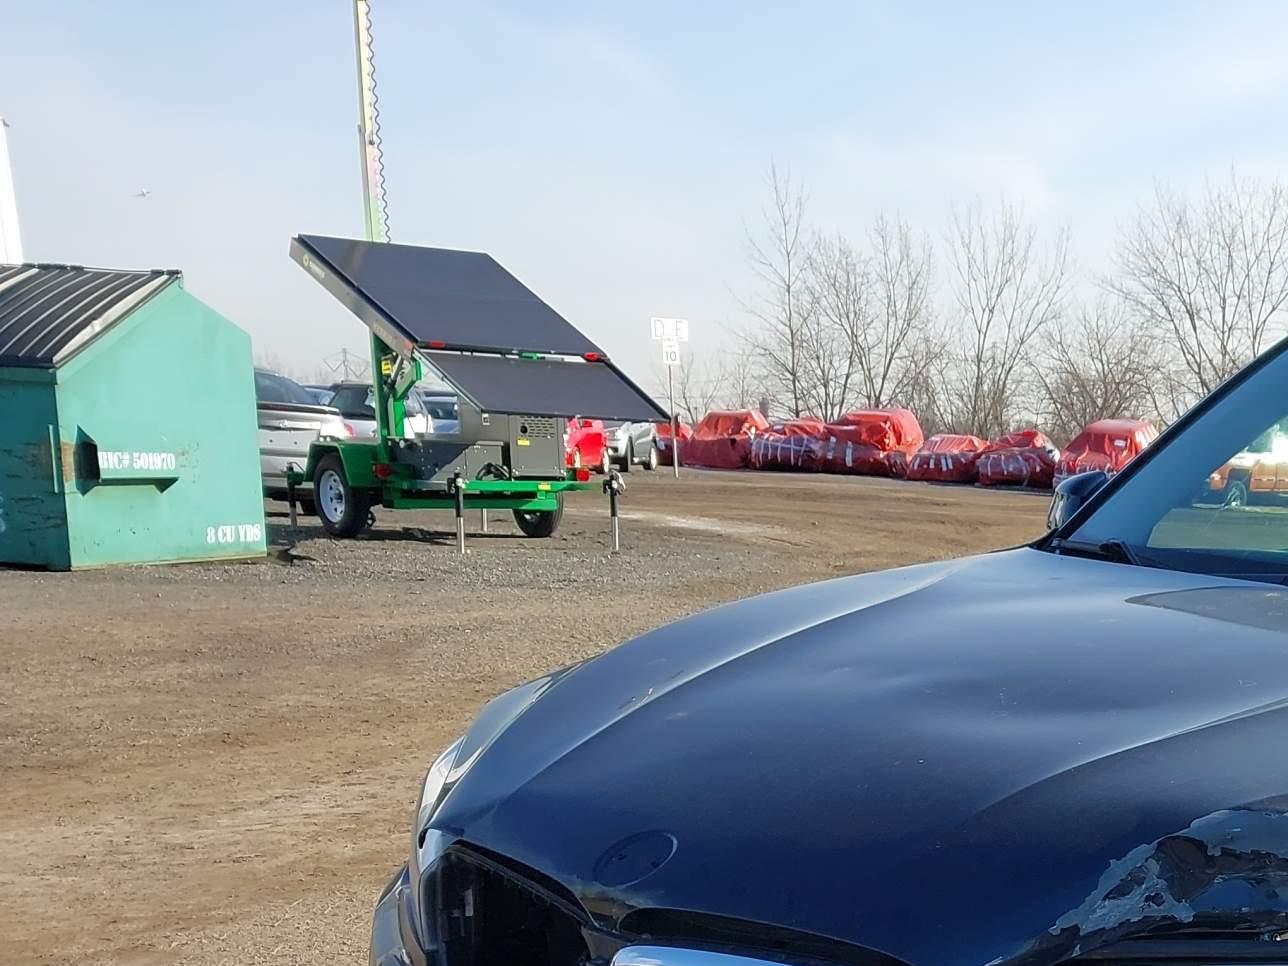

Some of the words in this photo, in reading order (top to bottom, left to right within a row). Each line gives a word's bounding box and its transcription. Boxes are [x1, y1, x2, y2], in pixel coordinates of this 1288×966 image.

[665, 350, 677, 362] 10
[132, 452, 176, 471] 501970
[207, 526, 216, 544] 8
[217, 524, 235, 543] CU
[238, 523, 261, 542] YDS
